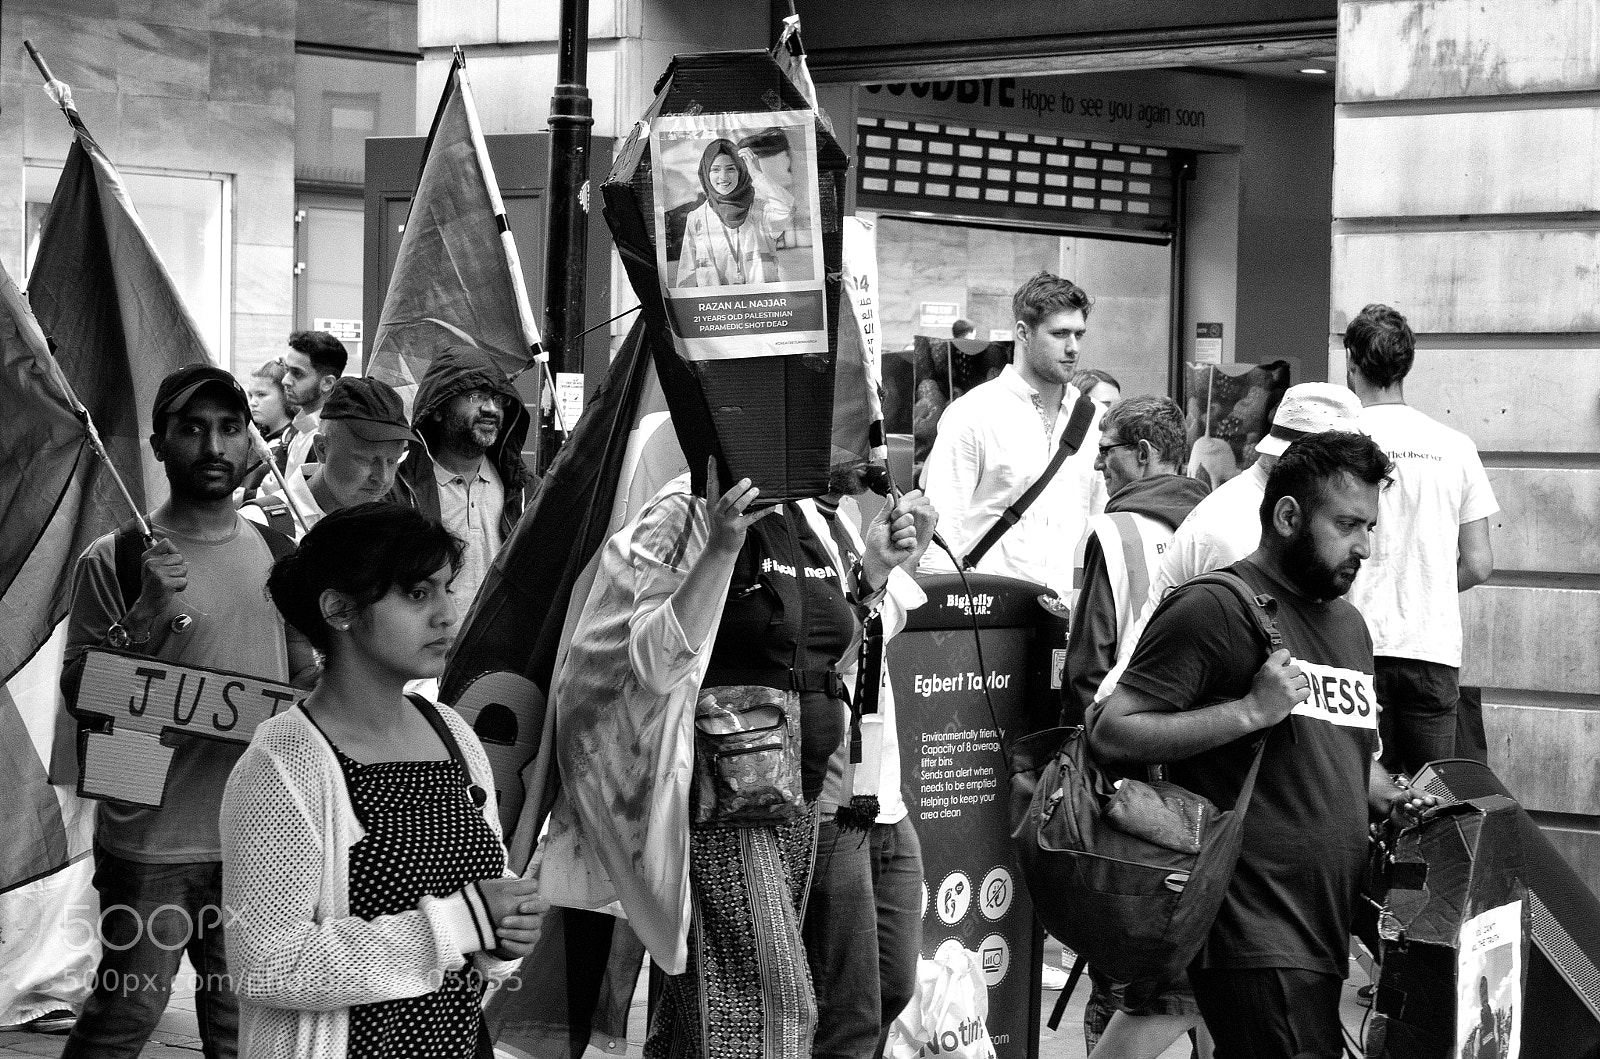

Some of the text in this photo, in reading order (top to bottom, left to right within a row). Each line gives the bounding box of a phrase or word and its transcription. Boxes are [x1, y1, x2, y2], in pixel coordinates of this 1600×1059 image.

[1021, 88, 1055, 117] Hope
[1061, 91, 1074, 114] to
[1080, 98, 1103, 117] see
[1108, 100, 1132, 123] you
[1138, 103, 1170, 128] again
[1176, 108, 1205, 127] soon
[698, 298, 787, 311] RAZAN AL NAJJAR
[702, 314, 726, 322] YEARS
[727, 313, 743, 321] OLD
[744, 310, 793, 320] PALESTINIAN
[700, 320, 788, 332] PARAMEDIC SHOT DEAD
[947, 594, 994, 609] Bigbelly
[914, 672, 963, 697] Egbert
[129, 667, 294, 731] JUST
[922, 729, 978, 742] Environmentally
[922, 744, 956, 756] Capacity
[957, 742, 965, 753] of
[966, 742, 971, 752] 8
[921, 756, 953, 768] litter bins
[921, 767, 993, 780] Sends an alert when
[921, 778, 997, 793] needs to be emptied
[921, 794, 996, 808] Helping to keep your
[920, 808, 961, 820] area clean
